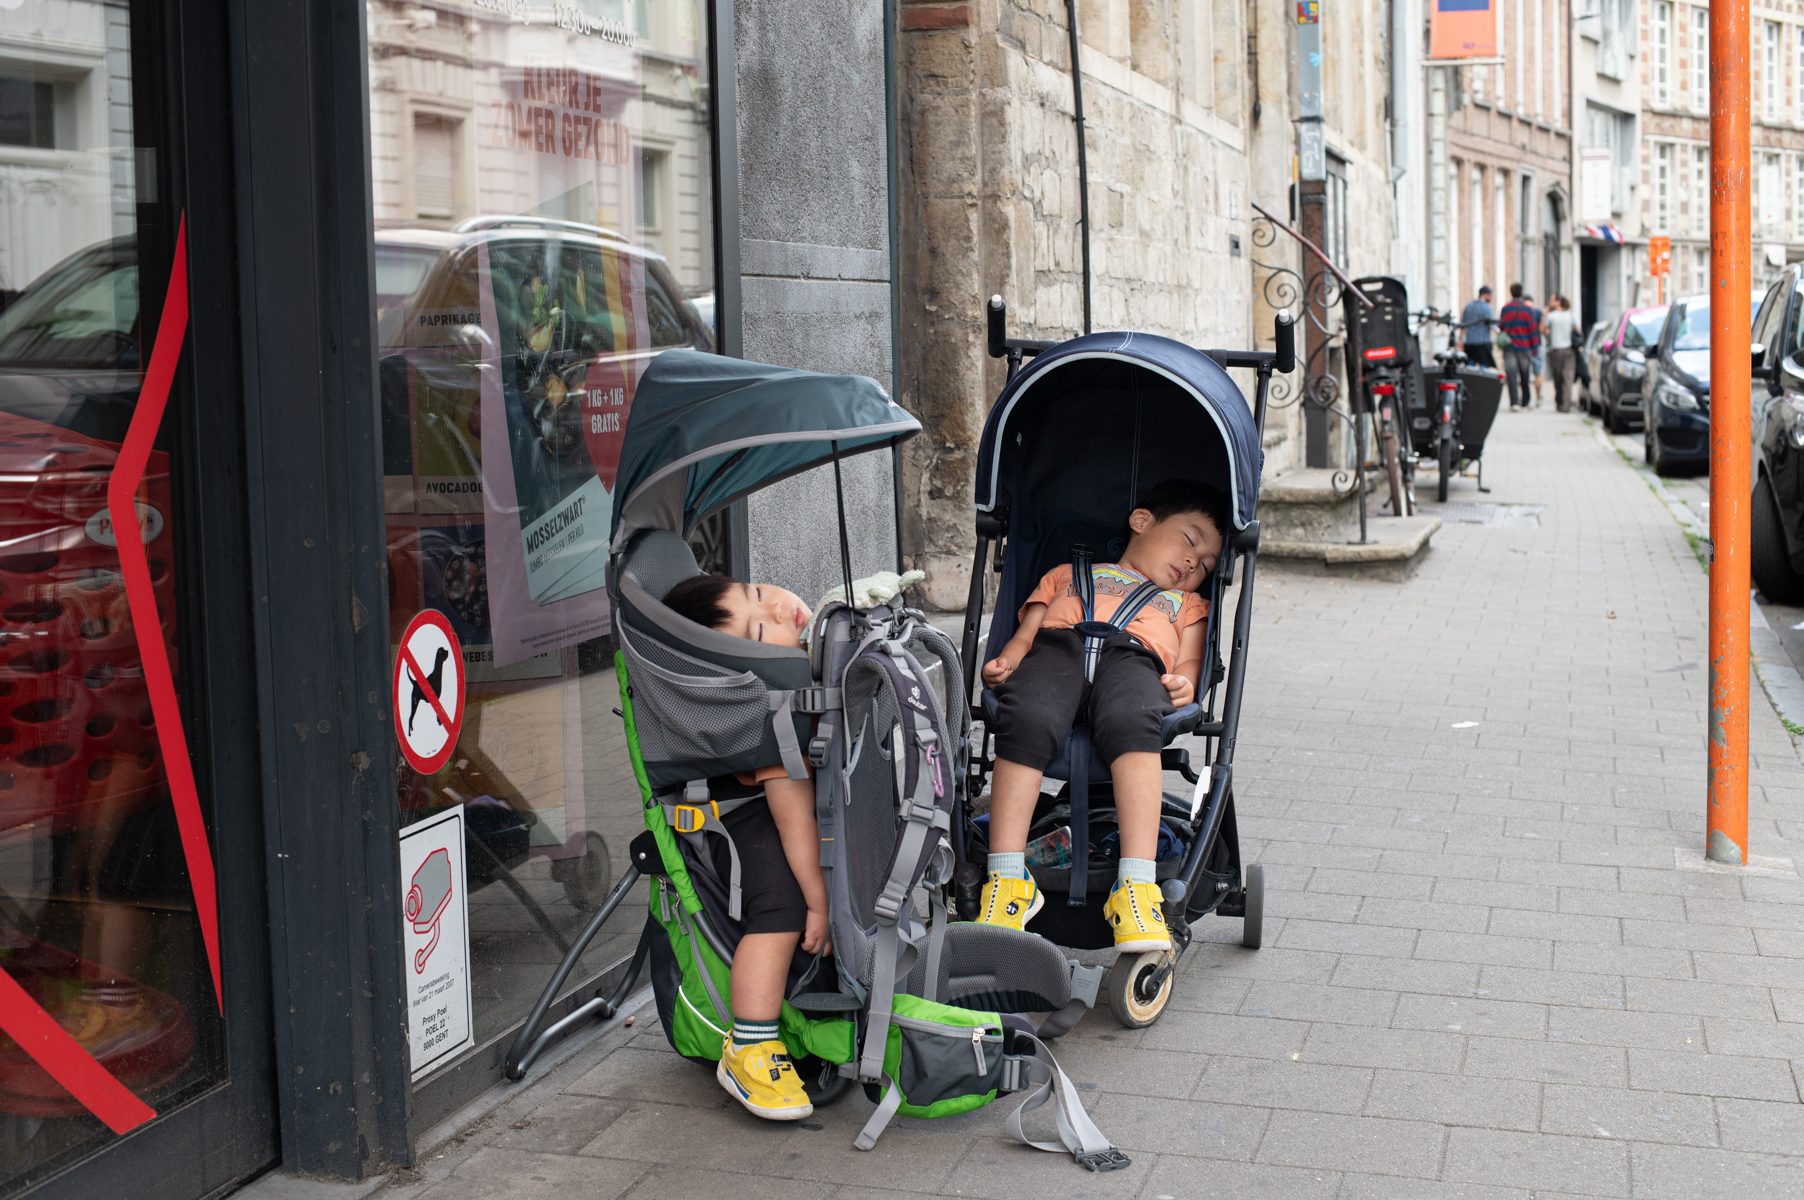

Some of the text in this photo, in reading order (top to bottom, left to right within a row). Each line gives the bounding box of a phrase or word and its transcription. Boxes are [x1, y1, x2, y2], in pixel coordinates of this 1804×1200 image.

[523, 62, 602, 114] KLEUR JE
[491, 101, 630, 166] ZOMER GEZOND
[591, 412, 620, 434] GRATIS
[422, 1005, 447, 1025] Proxy Poel
[425, 1023, 439, 1037] POEL
[436, 1029, 449, 1043] GENT
